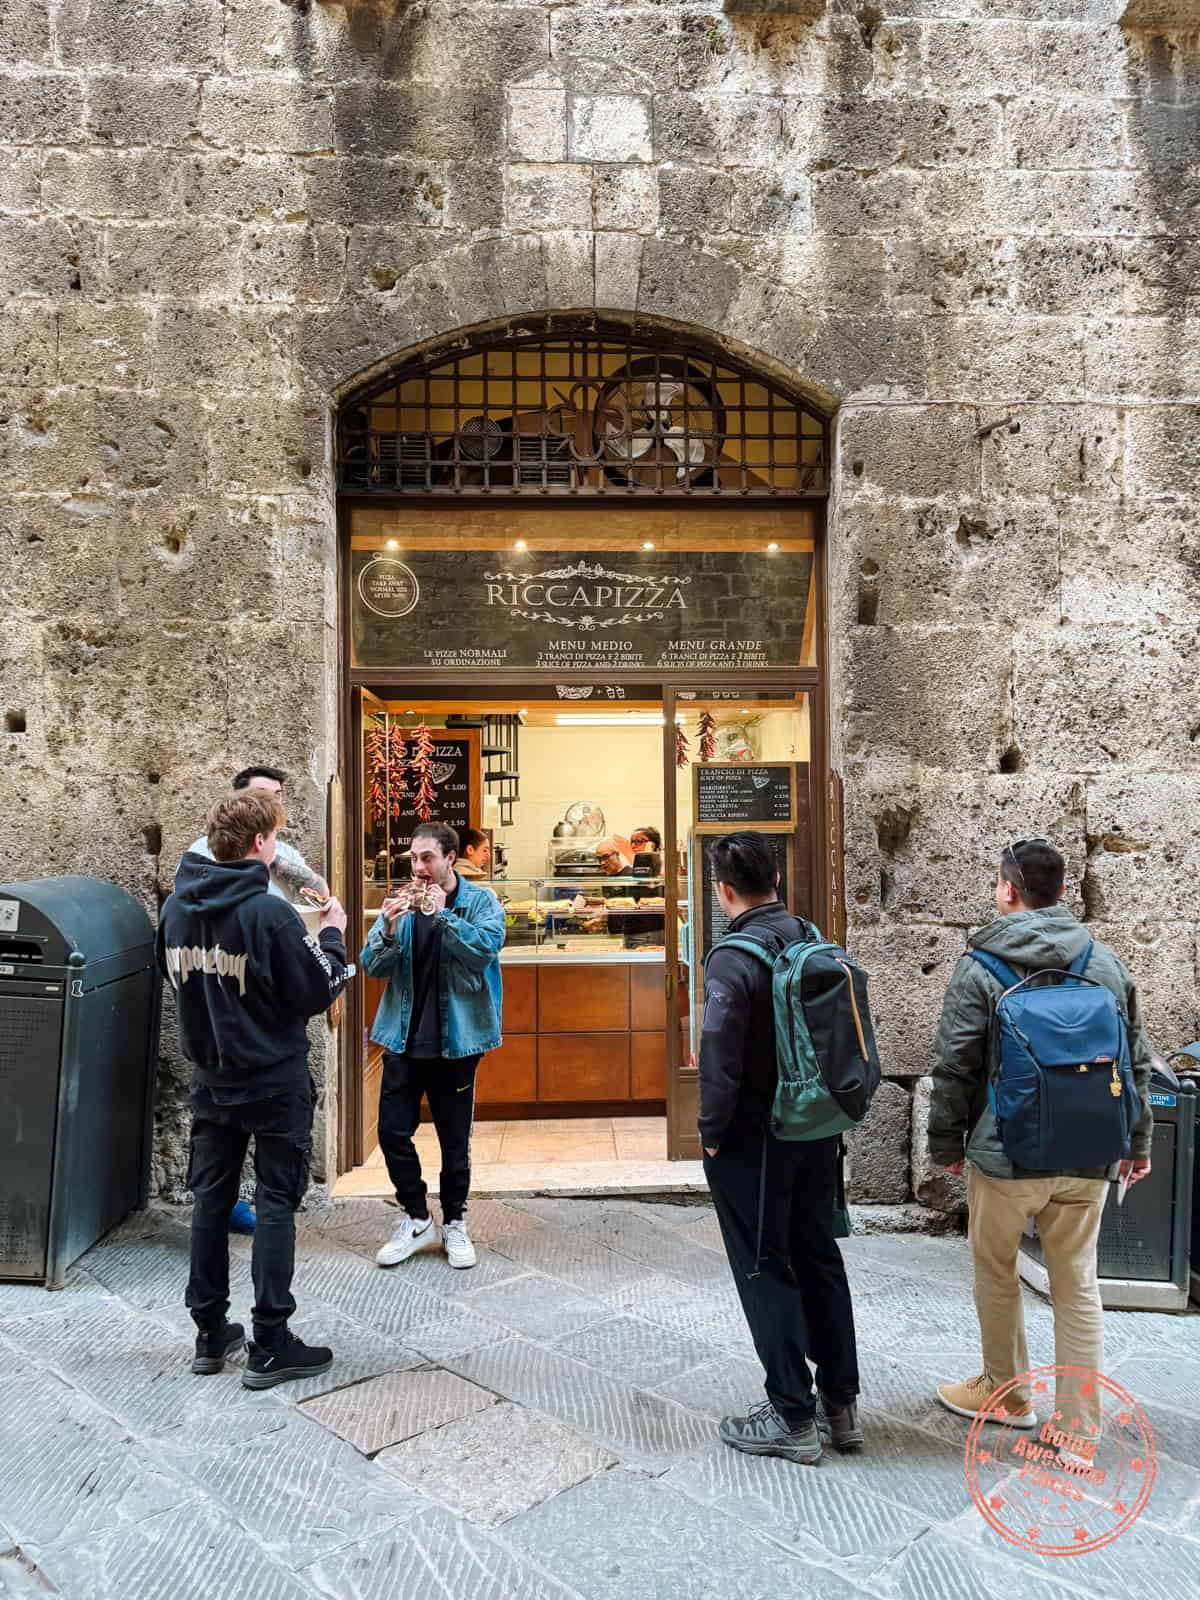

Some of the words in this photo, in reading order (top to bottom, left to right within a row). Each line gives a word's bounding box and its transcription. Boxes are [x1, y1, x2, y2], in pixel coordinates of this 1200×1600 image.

[484, 584, 688, 609] RICCAPIZZA
[548, 640, 586, 650] MENU
[591, 640, 633, 650] MEDIO
[668, 640, 705, 650] MENU
[710, 640, 762, 650] GRANDE
[459, 649, 507, 657] NORMALI
[661, 652, 668, 660] 6
[443, 658, 502, 666] ORDINAZIONE
